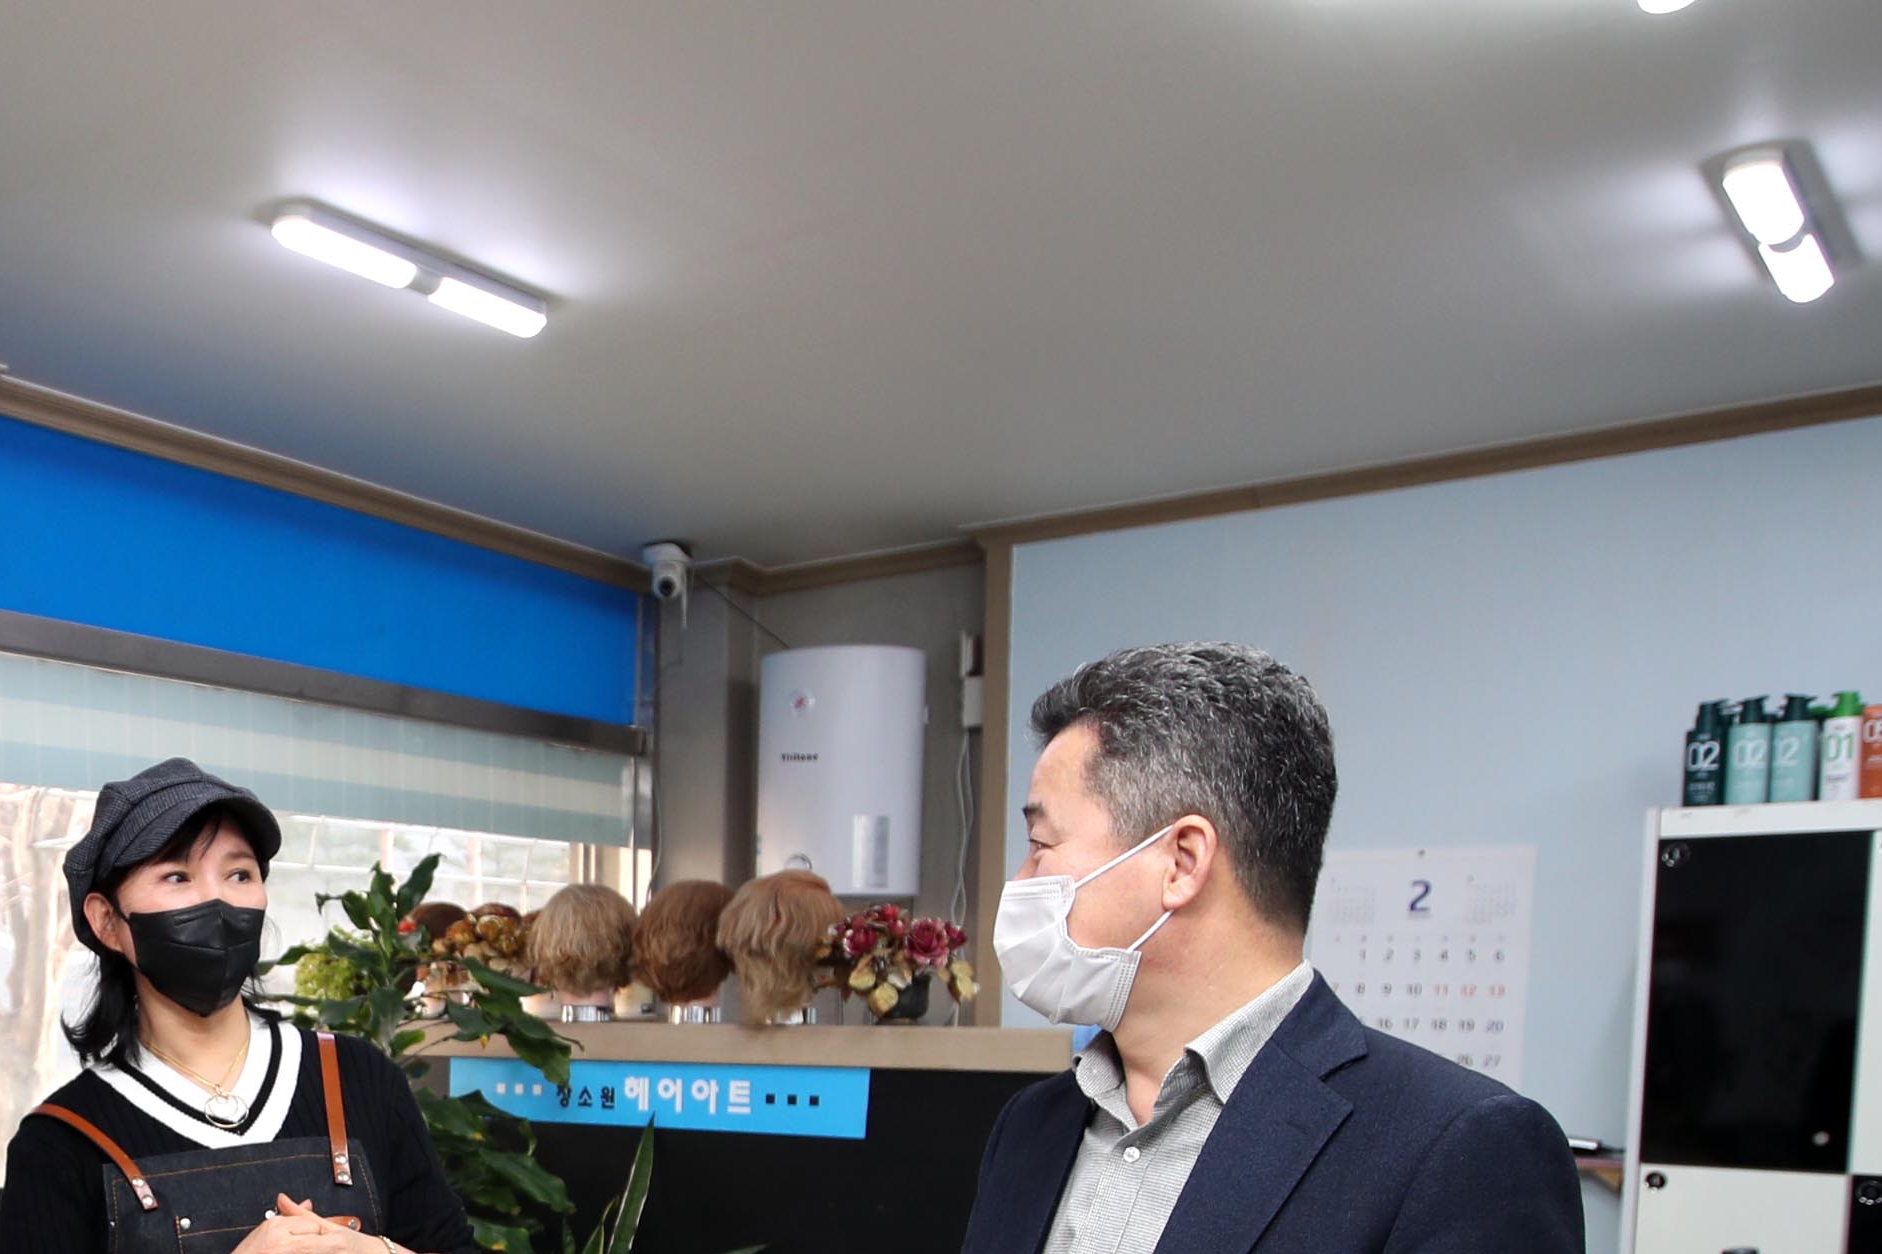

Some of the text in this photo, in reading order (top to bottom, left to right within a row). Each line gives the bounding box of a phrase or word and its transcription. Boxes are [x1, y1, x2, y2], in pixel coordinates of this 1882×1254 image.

[1687, 740, 1721, 771] 02
[1733, 738, 1768, 768] 02
[1408, 880, 1433, 912] 2
[1360, 950, 1505, 962] 1 2 3 4 5 6
[1356, 984, 1365, 994] 8
[1383, 984, 1392, 994] 9
[1406, 984, 1422, 995] 10
[1434, 984, 1449, 996] 11
[1460, 985, 1477, 997] 12
[1488, 985, 1505, 997] 13
[1378, 1018, 1504, 1033] 16 17 18 19 20
[1458, 1054, 1501, 1067] 26 27
[624, 1076, 752, 1116] 헤어아트
